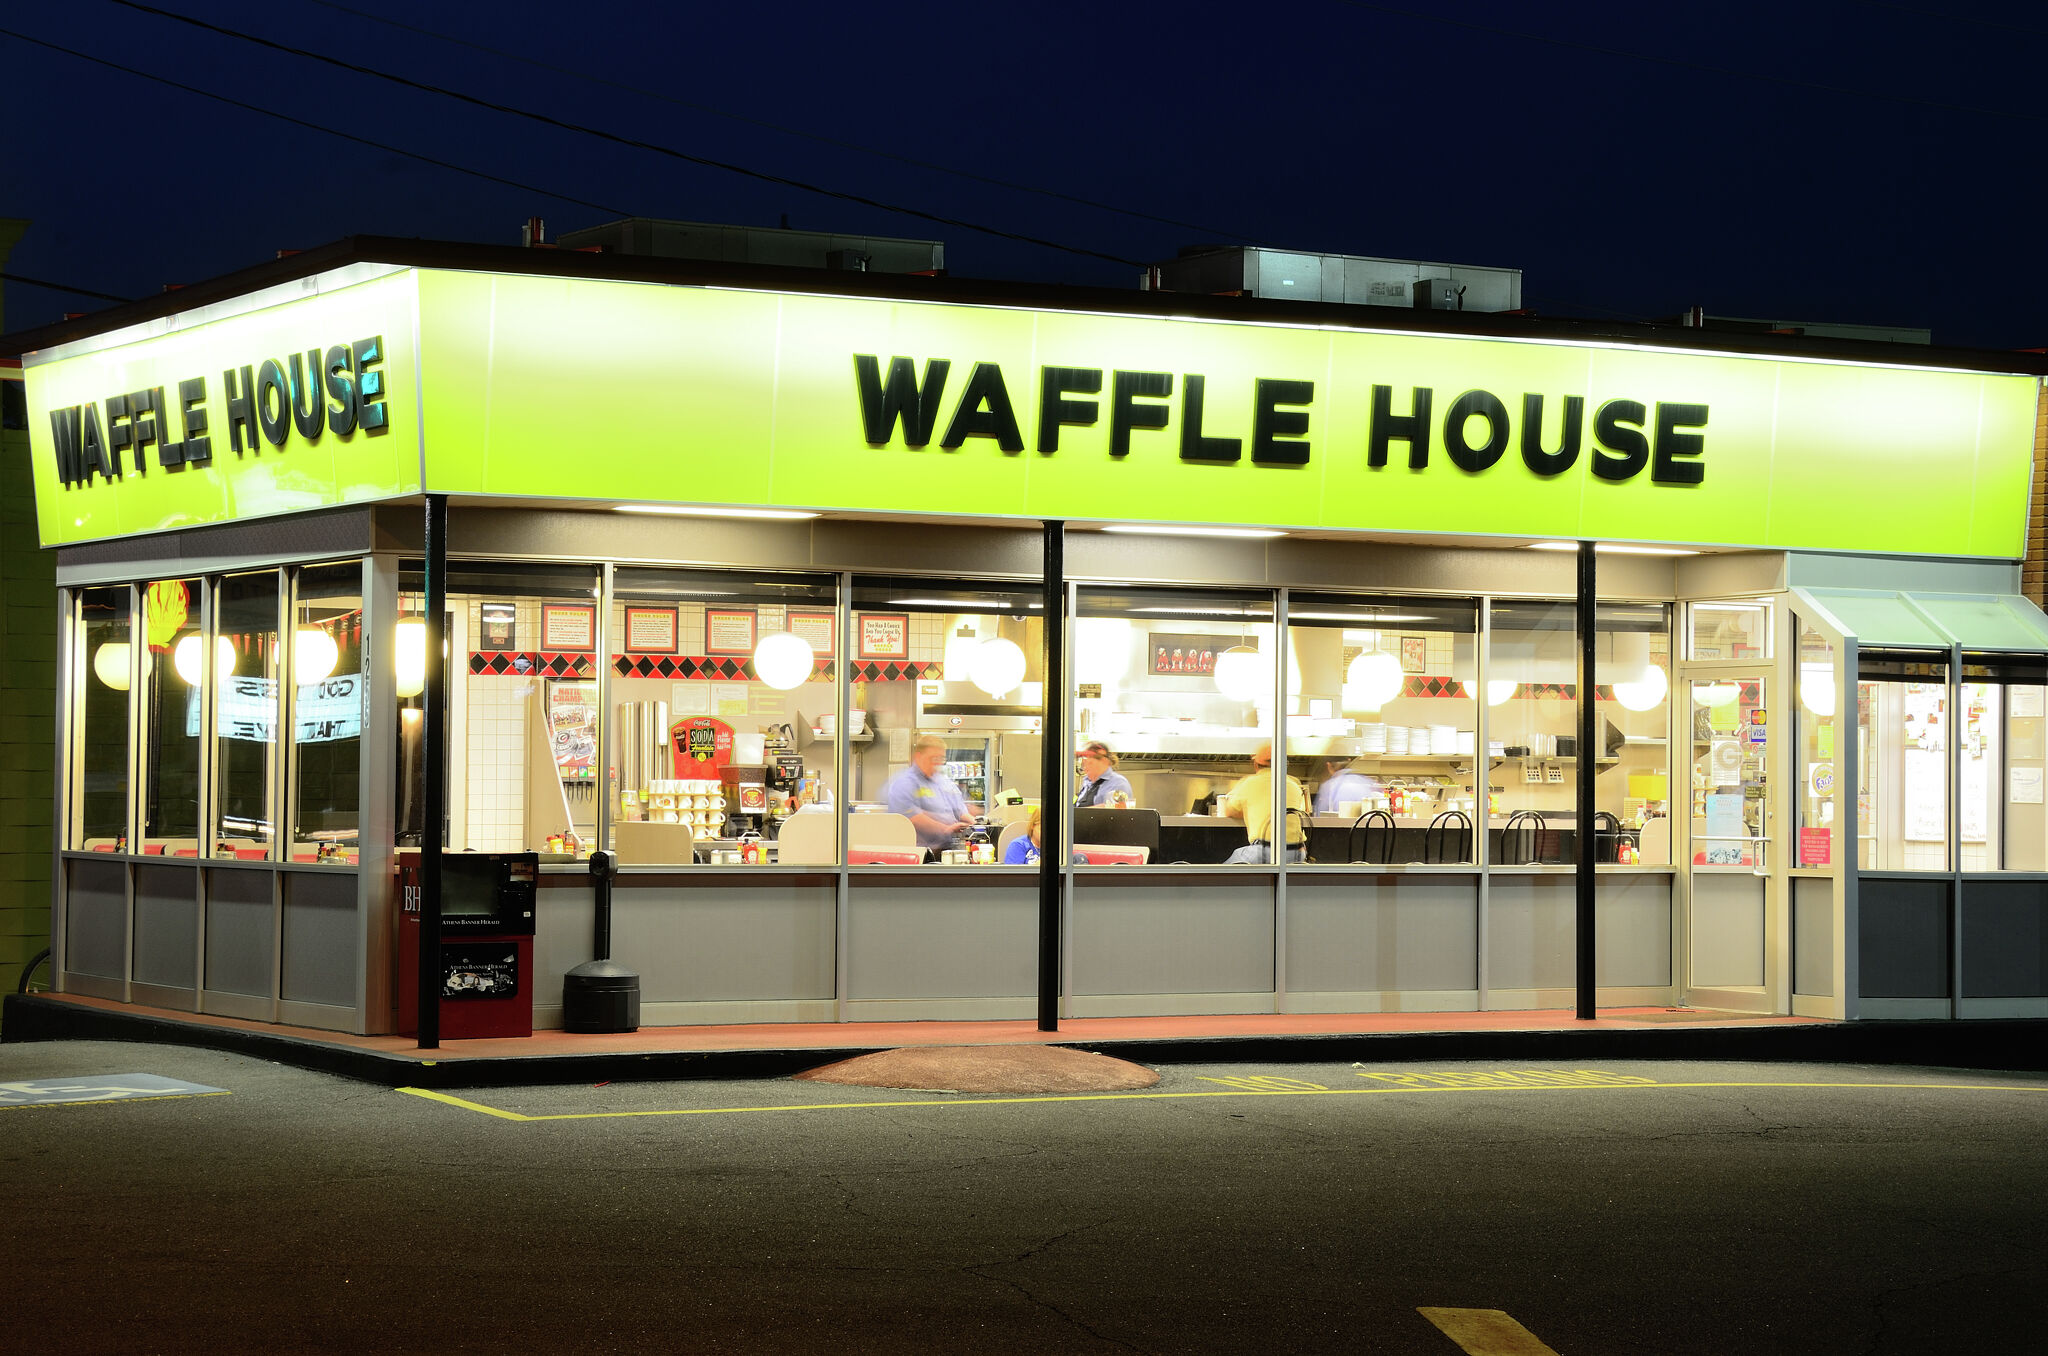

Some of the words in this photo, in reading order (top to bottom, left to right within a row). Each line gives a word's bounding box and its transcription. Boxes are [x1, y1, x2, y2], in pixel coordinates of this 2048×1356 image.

[50, 376, 213, 485] WAFFLE
[223, 335, 389, 453] HOUSE
[853, 353, 1315, 465] WAFFLE
[1366, 384, 1710, 484] HOUSE
[691, 730, 715, 743] SODA
[1753, 728, 1767, 737] VISA
[1815, 775, 1833, 791] Fan
[1196, 1075, 1329, 1092] NO
[1355, 1069, 1658, 1088] PARKING
